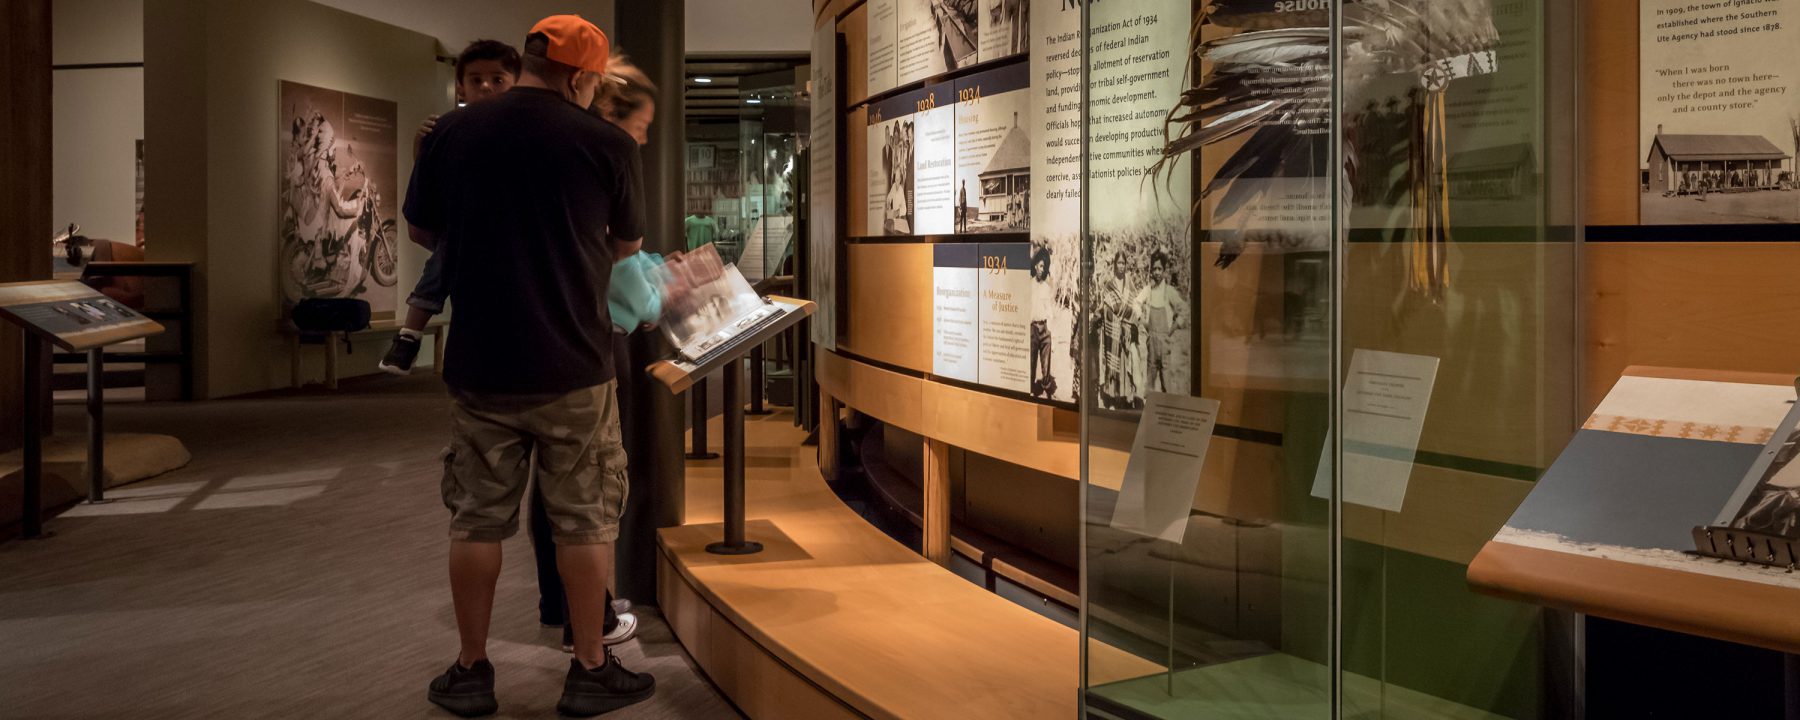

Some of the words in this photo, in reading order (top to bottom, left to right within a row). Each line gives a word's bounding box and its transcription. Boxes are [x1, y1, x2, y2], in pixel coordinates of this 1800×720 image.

[1666, 7, 1685, 15] 1909,
[1687, 4, 1699, 12] the
[1701, 2, 1721, 10] town
[1723, 0, 1731, 8] of
[1657, 18, 1698, 29] established
[1700, 15, 1724, 24] where
[1725, 14, 1738, 22] the
[1740, 9, 1777, 20] Southern
[1046, 36, 1056, 46] The
[1057, 31, 1075, 43] Indian
[1122, 18, 1133, 29] Act
[1134, 16, 1141, 26] of
[1143, 14, 1158, 26] 1934
[1657, 35, 1669, 43] Ute
[1671, 32, 1698, 43] Agency
[1700, 30, 1715, 38] had
[1716, 27, 1738, 37] stood
[1740, 25, 1760, 34] since
[1762, 22, 1782, 32] 1878.
[1046, 50, 1070, 63] reversed
[1095, 41, 1102, 53] of
[1103, 38, 1126, 51] federal
[1127, 34, 1149, 46] Indian
[1093, 57, 1123, 71] allotment
[1124, 54, 1131, 66] of
[1132, 50, 1170, 63] reservation
[1685, 67, 1688, 75] I
[1690, 66, 1707, 74] was
[1709, 64, 1729, 73] born
[1046, 86, 1060, 97] land,
[1060, 82, 1081, 96] providi
[1098, 77, 1115, 89] tribal
[1116, 68, 1170, 87] self-government
[1672, 80, 1695, 89] there
[1697, 78, 1714, 86] was
[1728, 75, 1750, 84] town
[959, 85, 980, 106] 1934
[1046, 104, 1057, 114] and
[1058, 101, 1081, 114] funding
[1089, 96, 1110, 107] nomic
[1112, 90, 1157, 106] development.
[1657, 94, 1675, 103] only
[1677, 92, 1691, 101] the
[1693, 91, 1716, 101] depot
[1719, 89, 1735, 97] and
[1737, 87, 1752, 96] the
[1754, 86, 1786, 96] agency
[917, 92, 935, 117] 1938
[1672, 105, 1688, 114] and
[1697, 103, 1727, 113] county
[1046, 119, 1069, 131] Officials
[1070, 118, 1081, 130] hop
[1103, 110, 1133, 124] increased
[1134, 108, 1168, 120] autonomy
[1046, 137, 1063, 148] would
[1064, 137, 1081, 147] succe
[1095, 131, 1128, 145] developing
[1089, 151, 1101, 161] tive
[1102, 148, 1144, 161] communities
[1146, 145, 1164, 156] whe
[1046, 172, 1070, 183] coercive,
[1117, 165, 1141, 180] policies
[1046, 189, 1064, 201] clearly
[983, 255, 1007, 276] 1934
[989, 289, 1012, 301] Measure
[991, 301, 998, 312] of
[998, 301, 1018, 313] Justice
